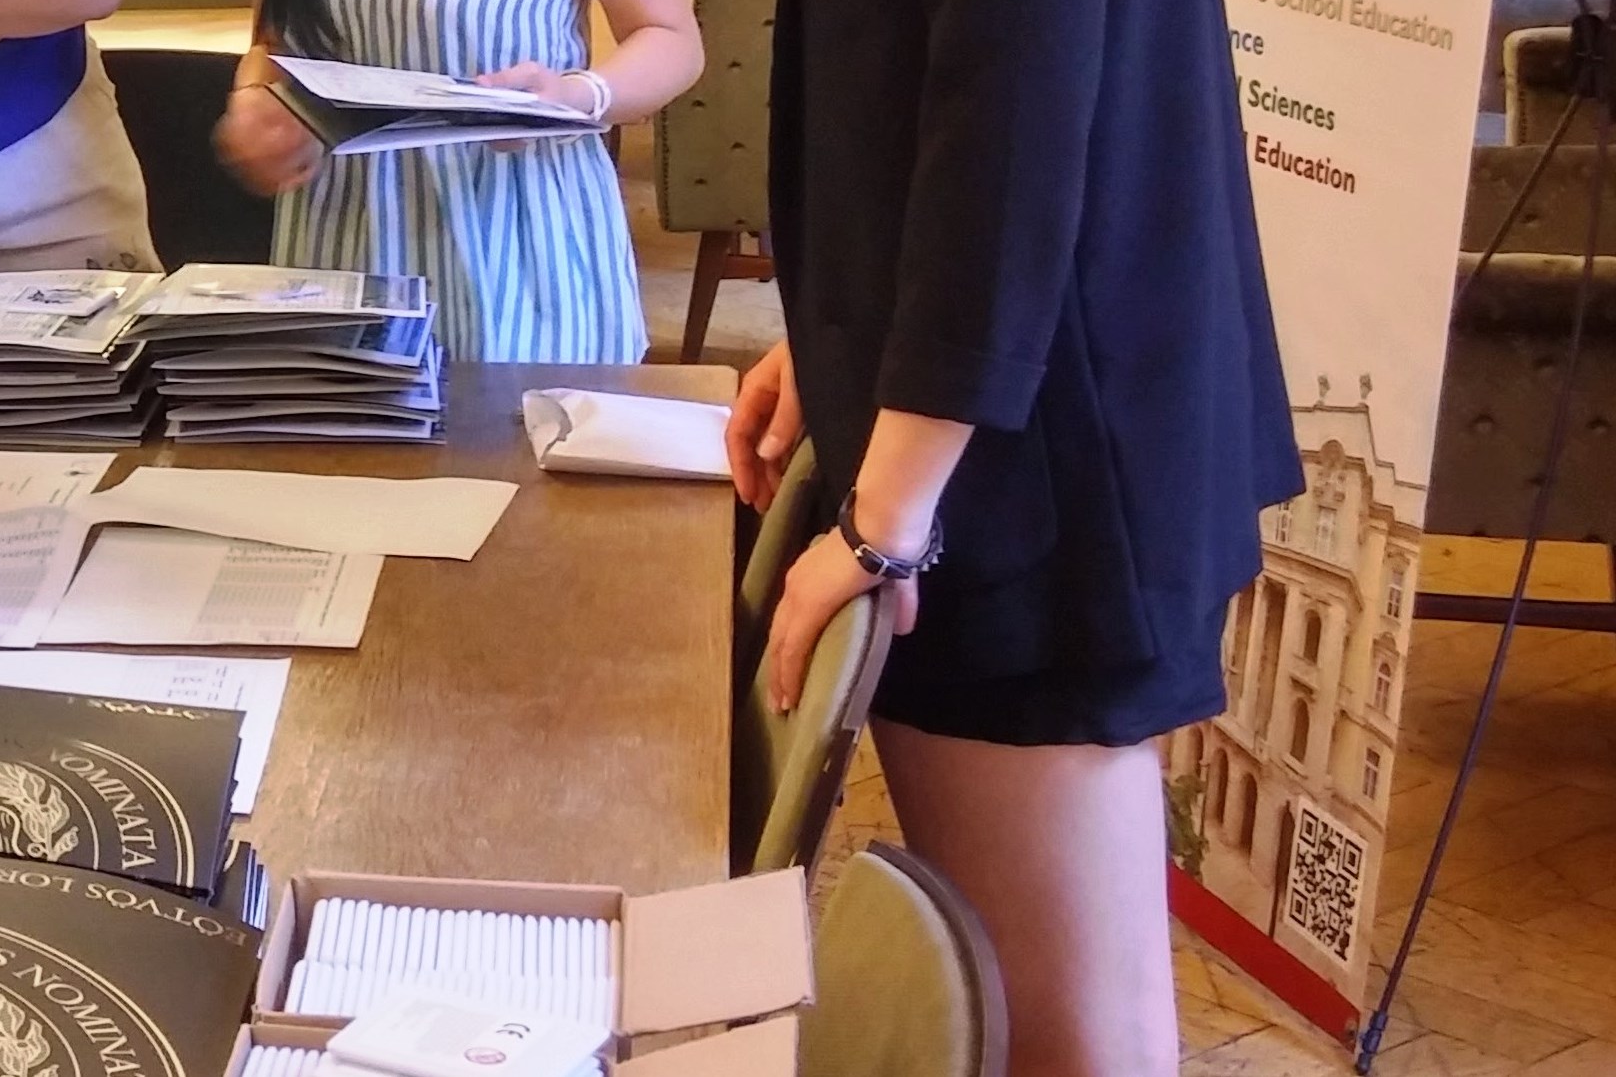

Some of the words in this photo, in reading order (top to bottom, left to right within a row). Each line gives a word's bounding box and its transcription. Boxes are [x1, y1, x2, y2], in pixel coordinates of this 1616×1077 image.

[1247, 79, 1336, 131] Sciences
[1254, 134, 1356, 194] Education
[16, 963, 145, 1077] NOMINA
